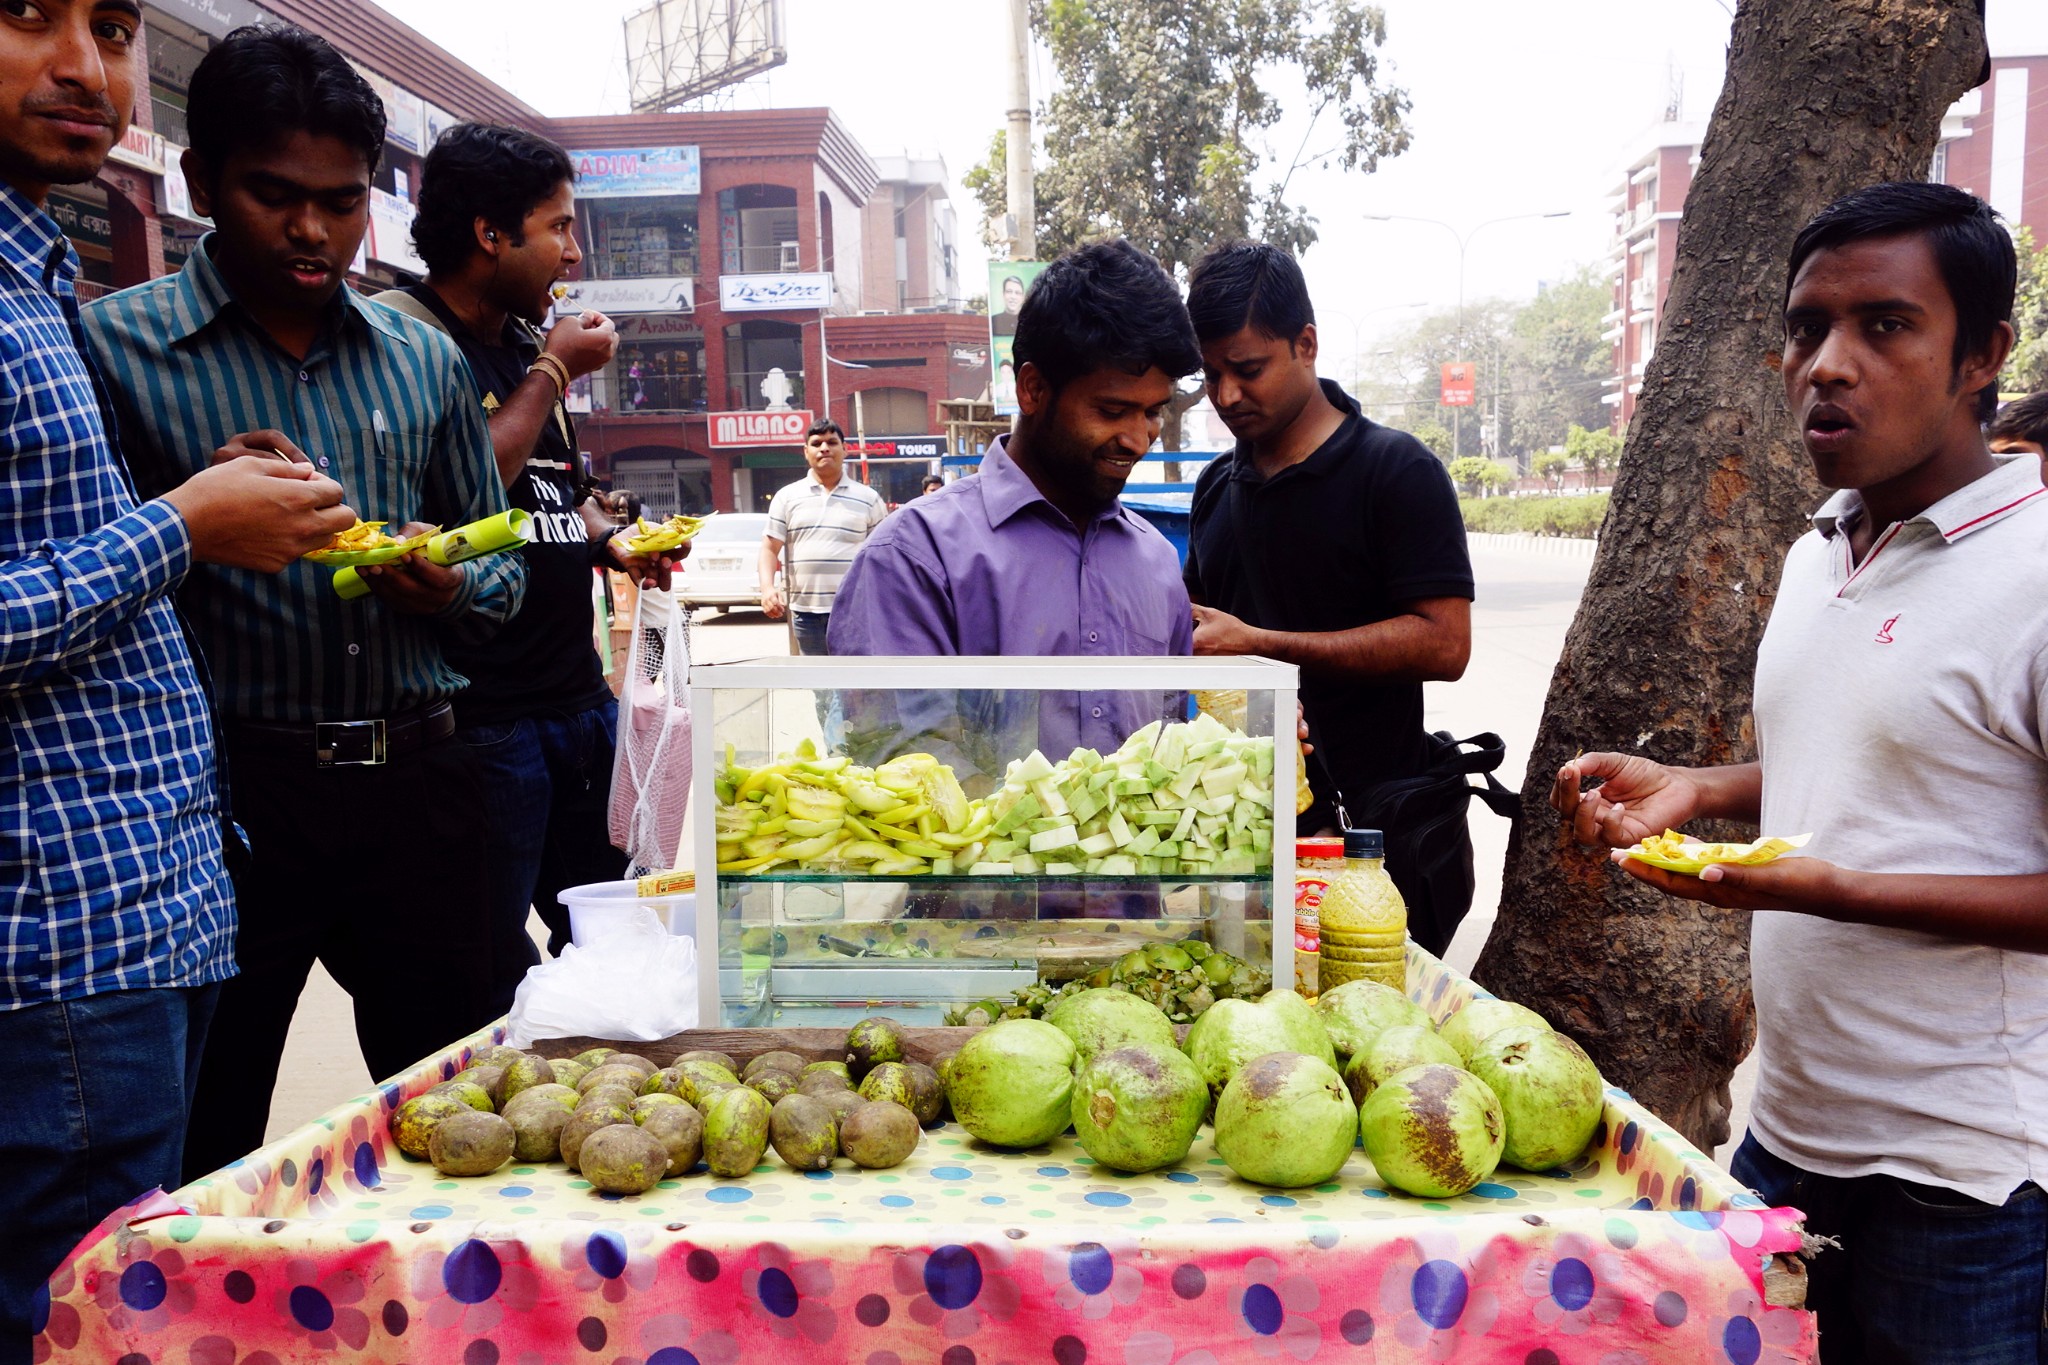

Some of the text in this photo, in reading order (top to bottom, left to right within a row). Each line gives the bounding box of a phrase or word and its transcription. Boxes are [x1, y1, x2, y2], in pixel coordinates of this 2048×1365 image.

[574, 155, 638, 176] ADIM
[717, 414, 804, 442] MILANO
[897, 444, 937, 455] TOUCH
[1295, 908, 1315, 916] ubble
